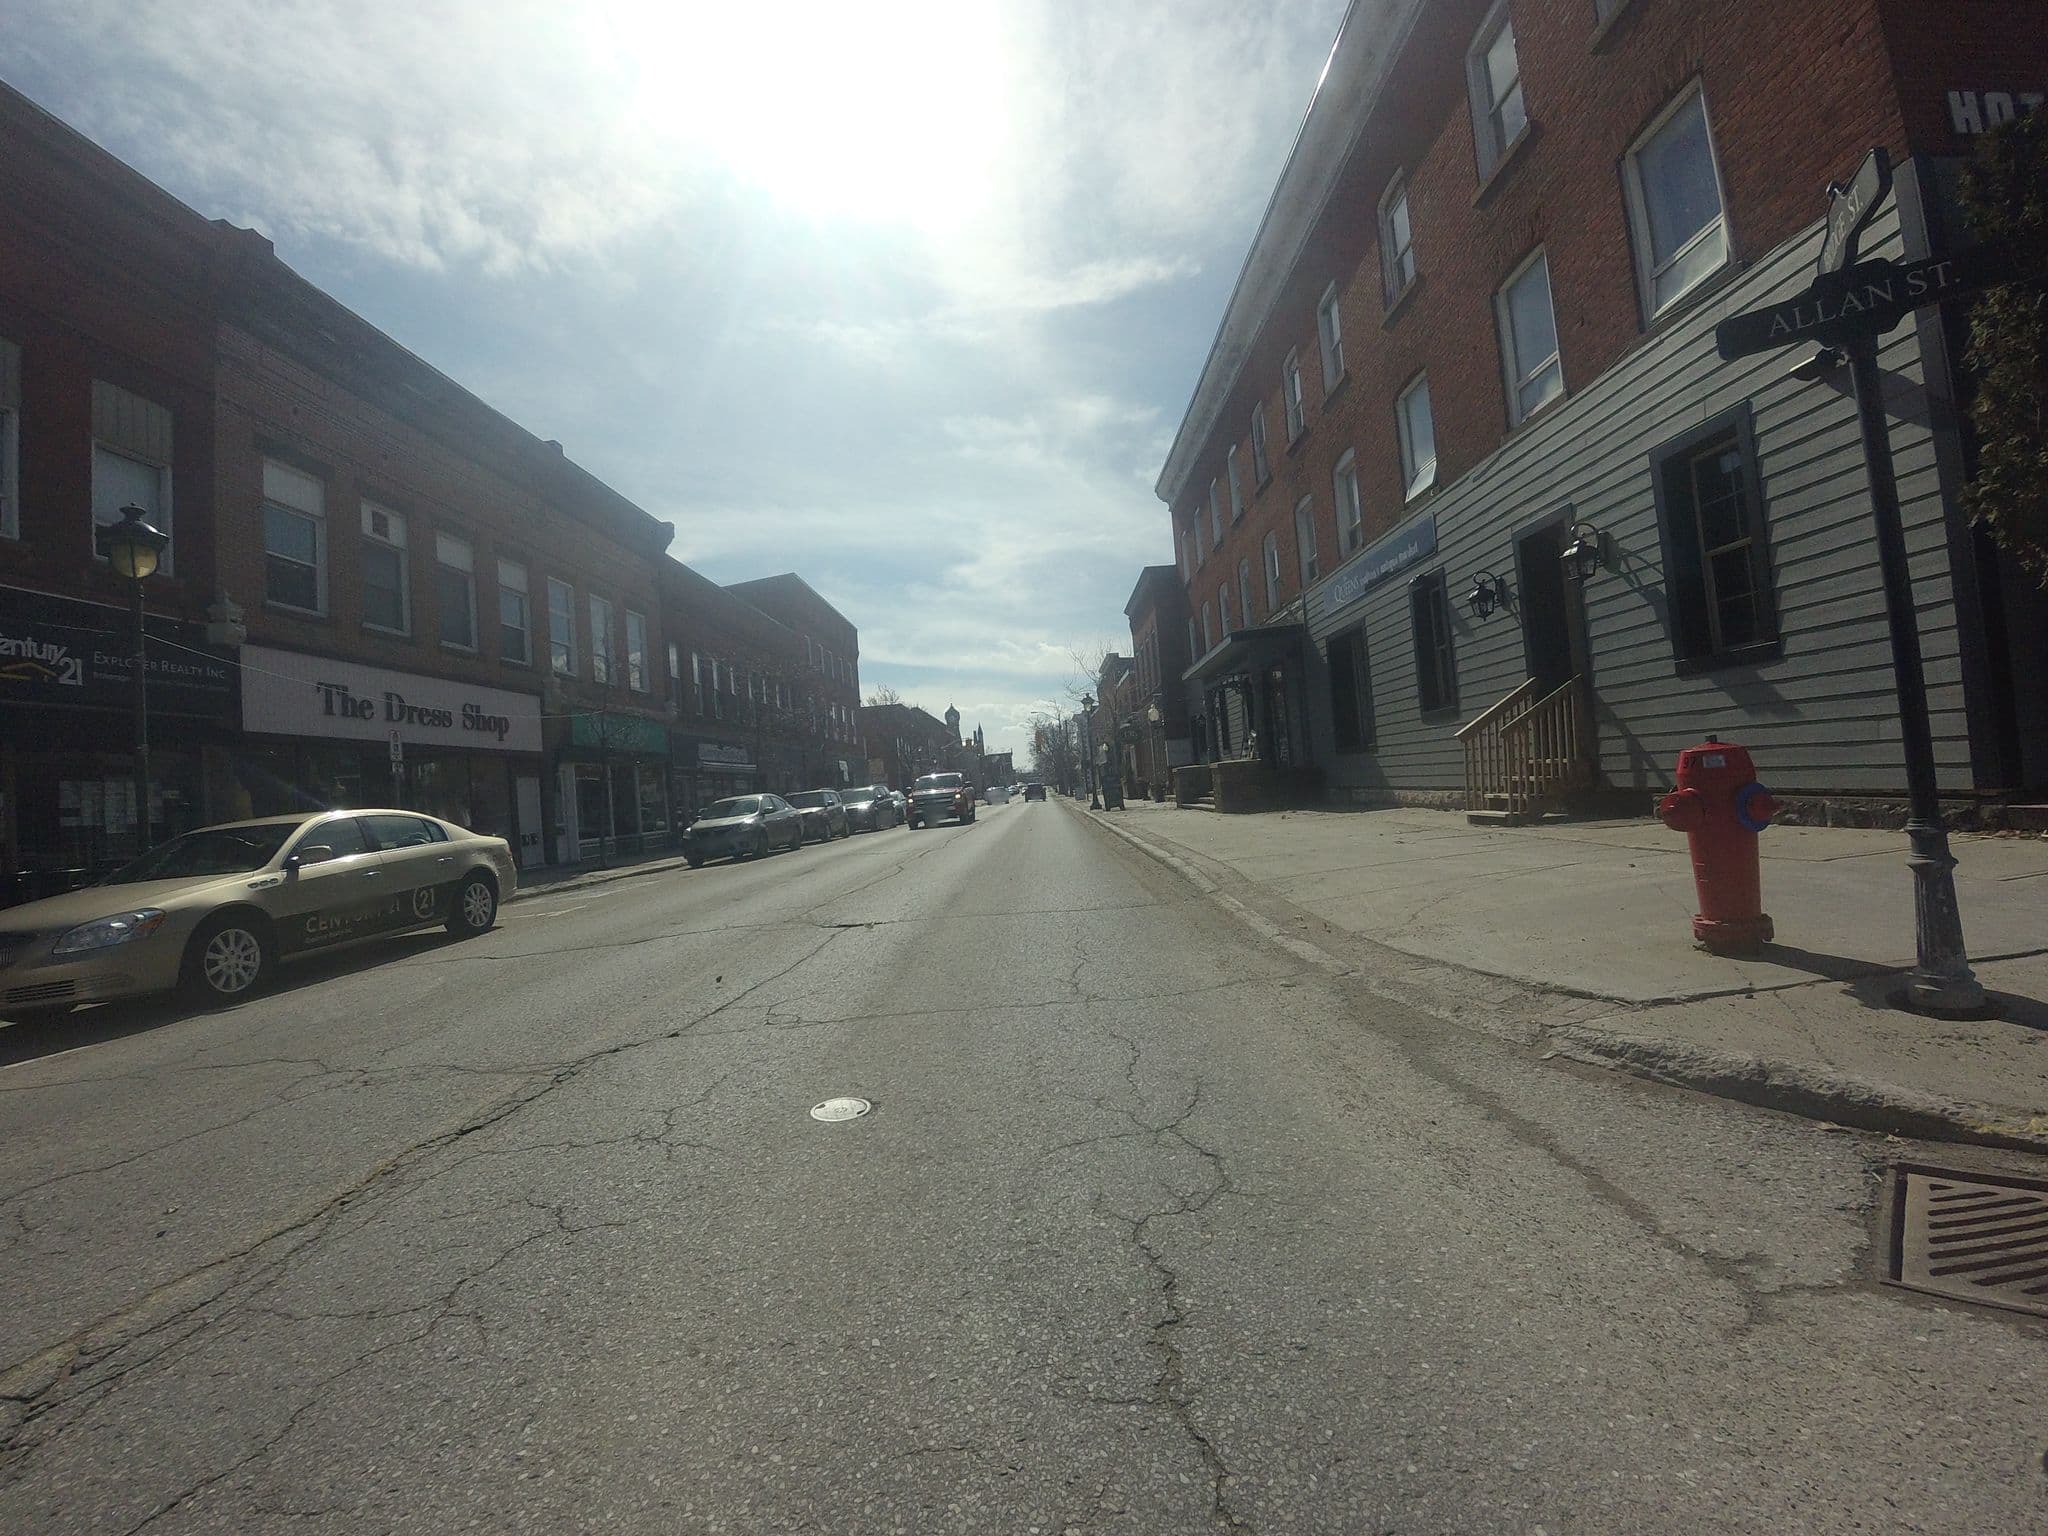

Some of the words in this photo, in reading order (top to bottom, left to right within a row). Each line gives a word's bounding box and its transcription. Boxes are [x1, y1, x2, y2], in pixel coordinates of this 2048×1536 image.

[1769, 279, 1893, 337] ALLAN
[1905, 261, 1961, 296] ST.
[0, 633, 68, 665] entury
[93, 651, 157, 671] EXPLOER
[161, 659, 203, 679] REALTY
[58, 656, 83, 686] 21
[316, 681, 374, 721] The
[383, 691, 453, 729] Dress
[461, 702, 510, 741] Shop
